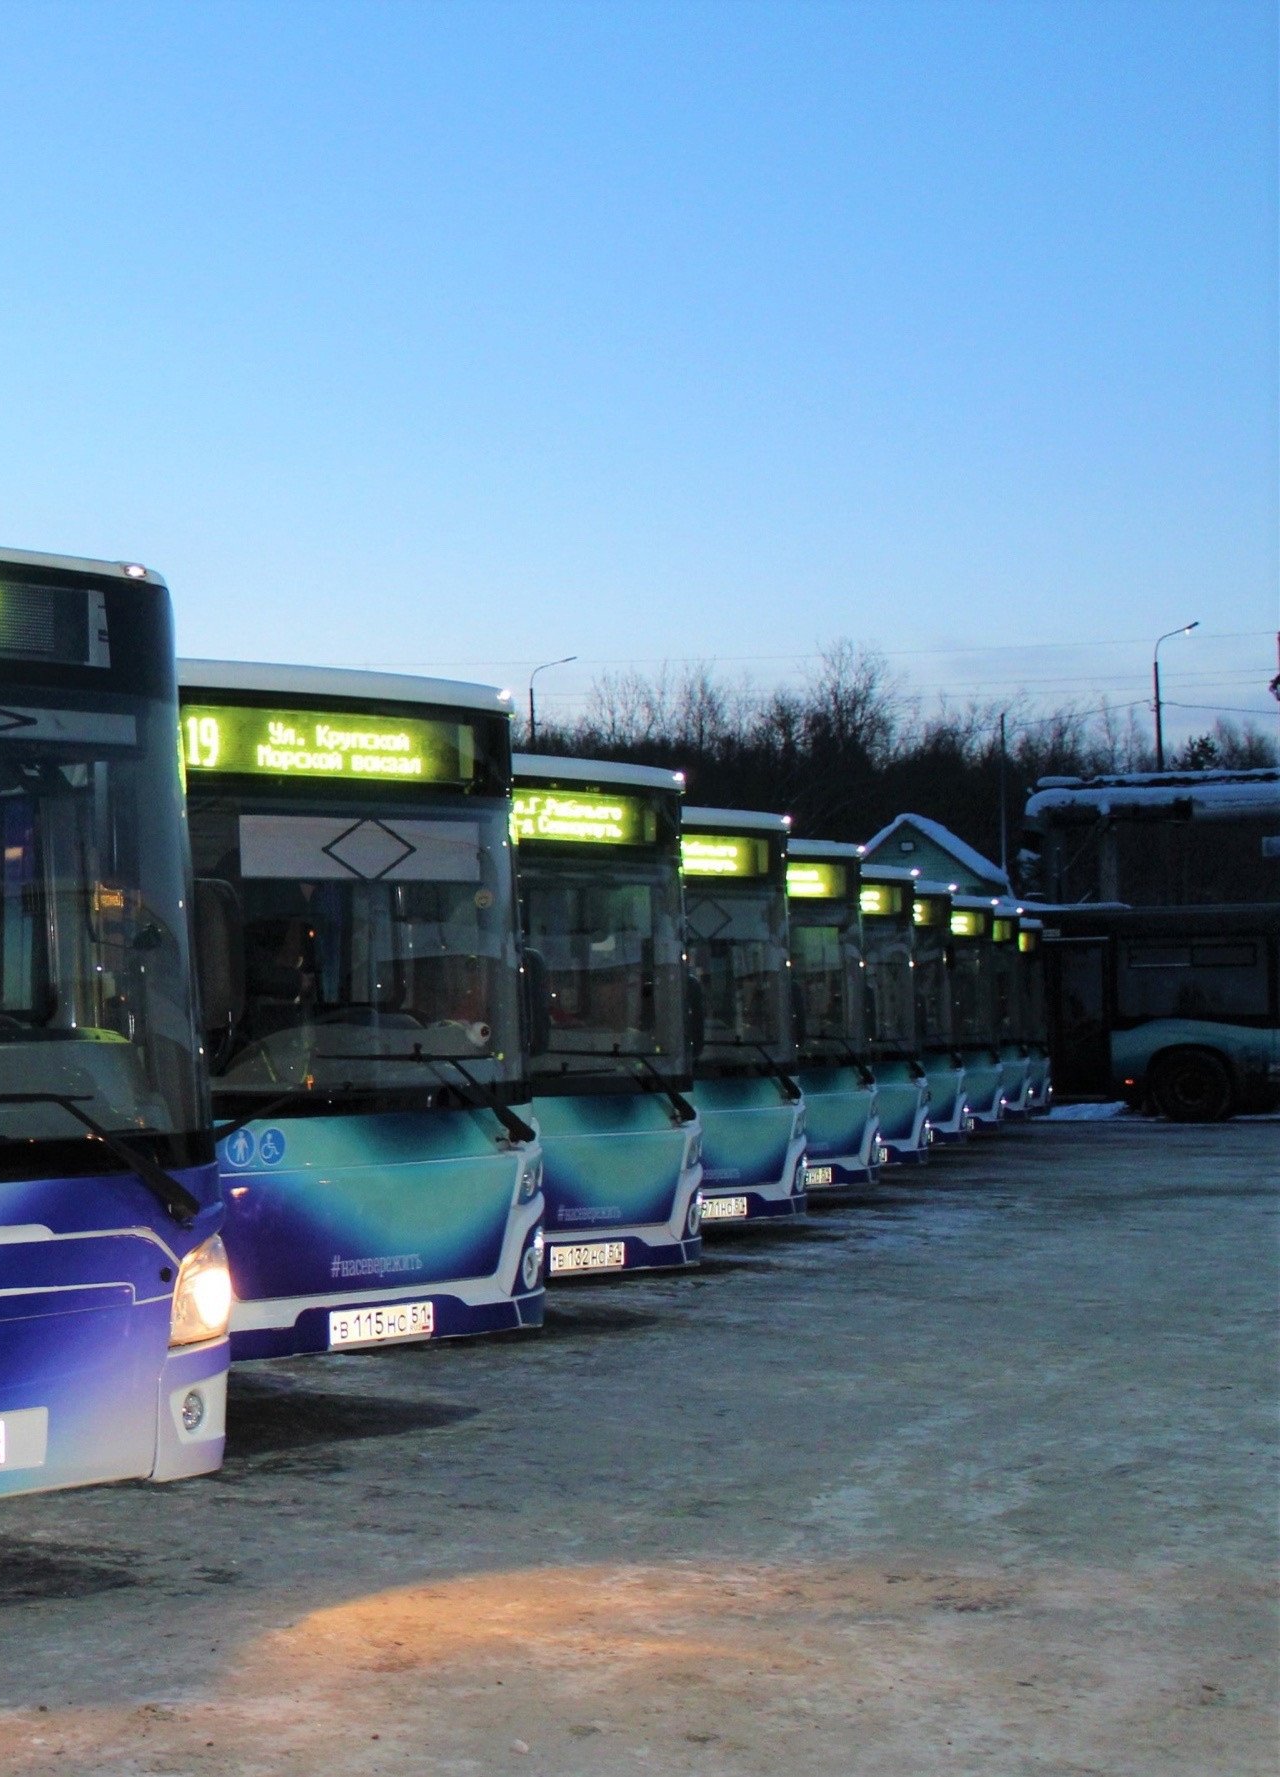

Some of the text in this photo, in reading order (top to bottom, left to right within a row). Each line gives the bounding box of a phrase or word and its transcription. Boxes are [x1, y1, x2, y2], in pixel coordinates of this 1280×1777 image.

[186, 716, 220, 768] 19
[268, 721, 411, 751] Ул. Крупской
[256, 744, 423, 775] Морской вокзал
